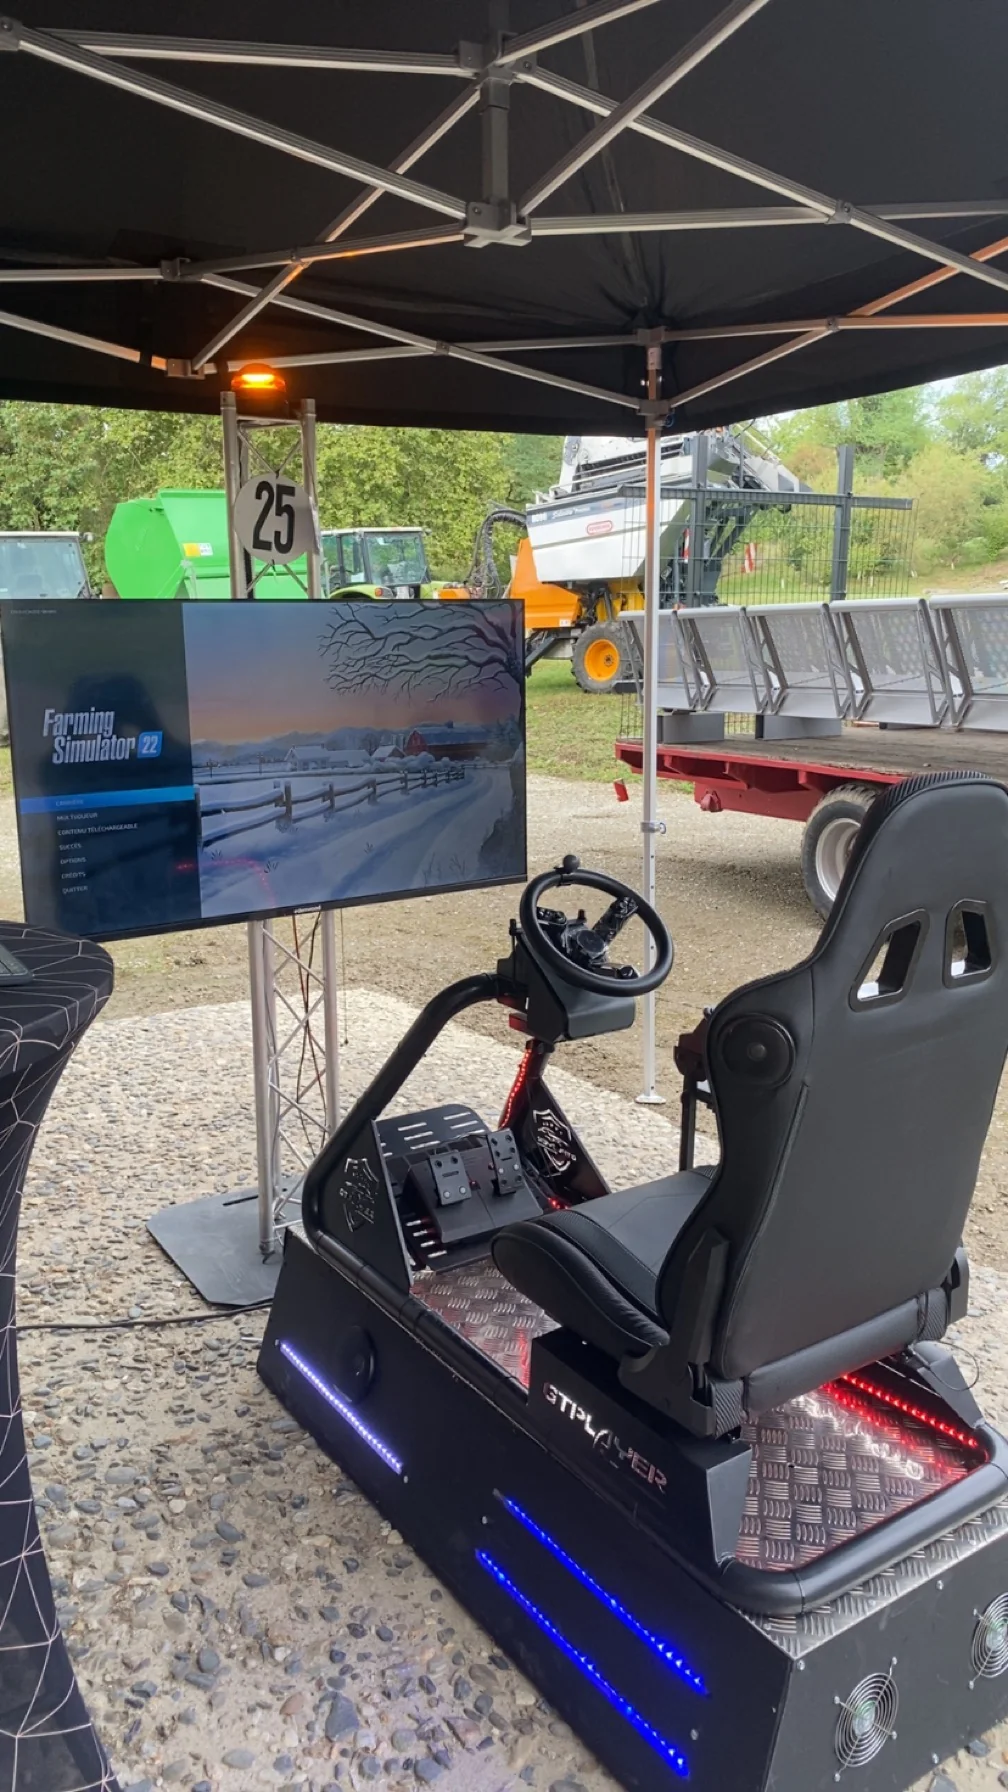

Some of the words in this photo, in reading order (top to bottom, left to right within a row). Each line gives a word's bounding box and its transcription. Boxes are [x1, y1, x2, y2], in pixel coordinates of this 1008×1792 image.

[252, 481, 296, 554] 25
[43, 706, 115, 738] Farming
[52, 734, 136, 764] Simulator
[142, 736, 158, 754] 22
[57, 828, 87, 836] CONTENU
[62, 885, 88, 895] QUITTER
